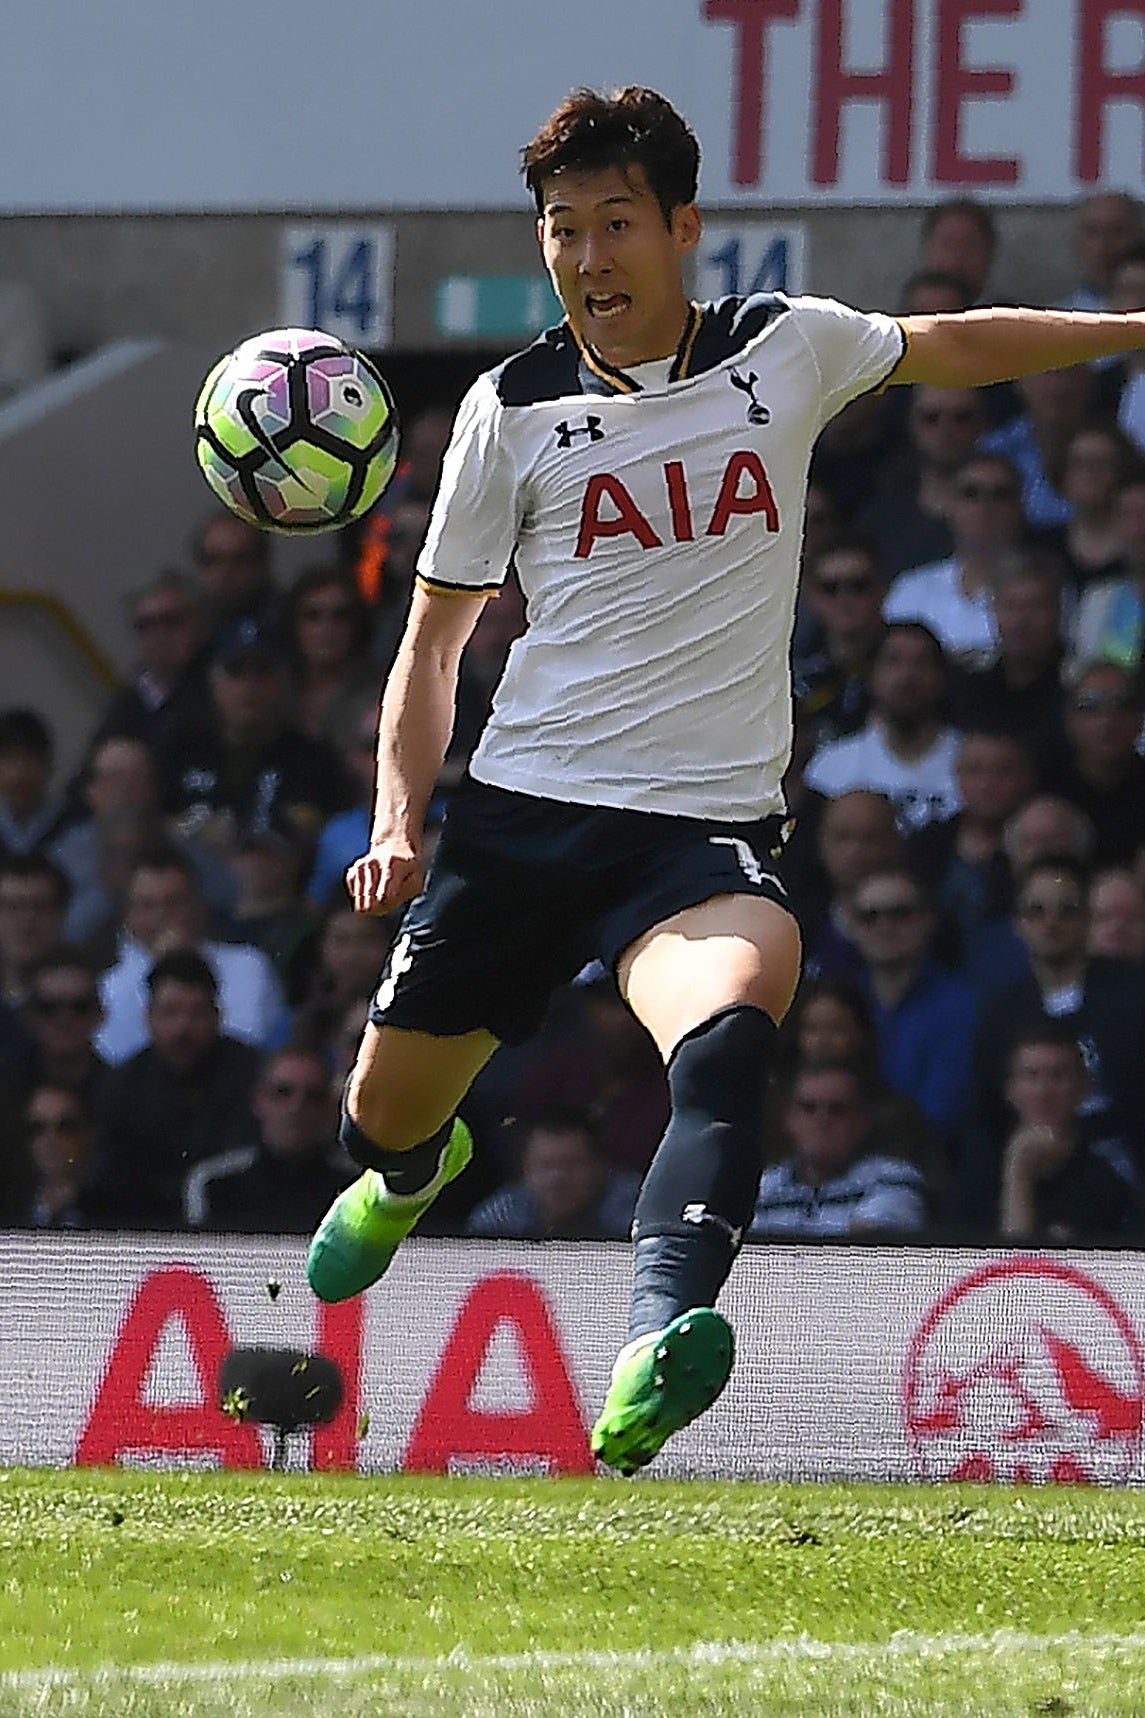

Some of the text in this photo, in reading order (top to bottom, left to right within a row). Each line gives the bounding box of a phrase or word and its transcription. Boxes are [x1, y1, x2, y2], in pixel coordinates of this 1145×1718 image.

[704, 0, 1019, 186] THE
[292, 238, 378, 334] 14
[702, 237, 796, 298] 14
[573, 450, 781, 559] AIA
[74, 1262, 600, 1477] AIA
